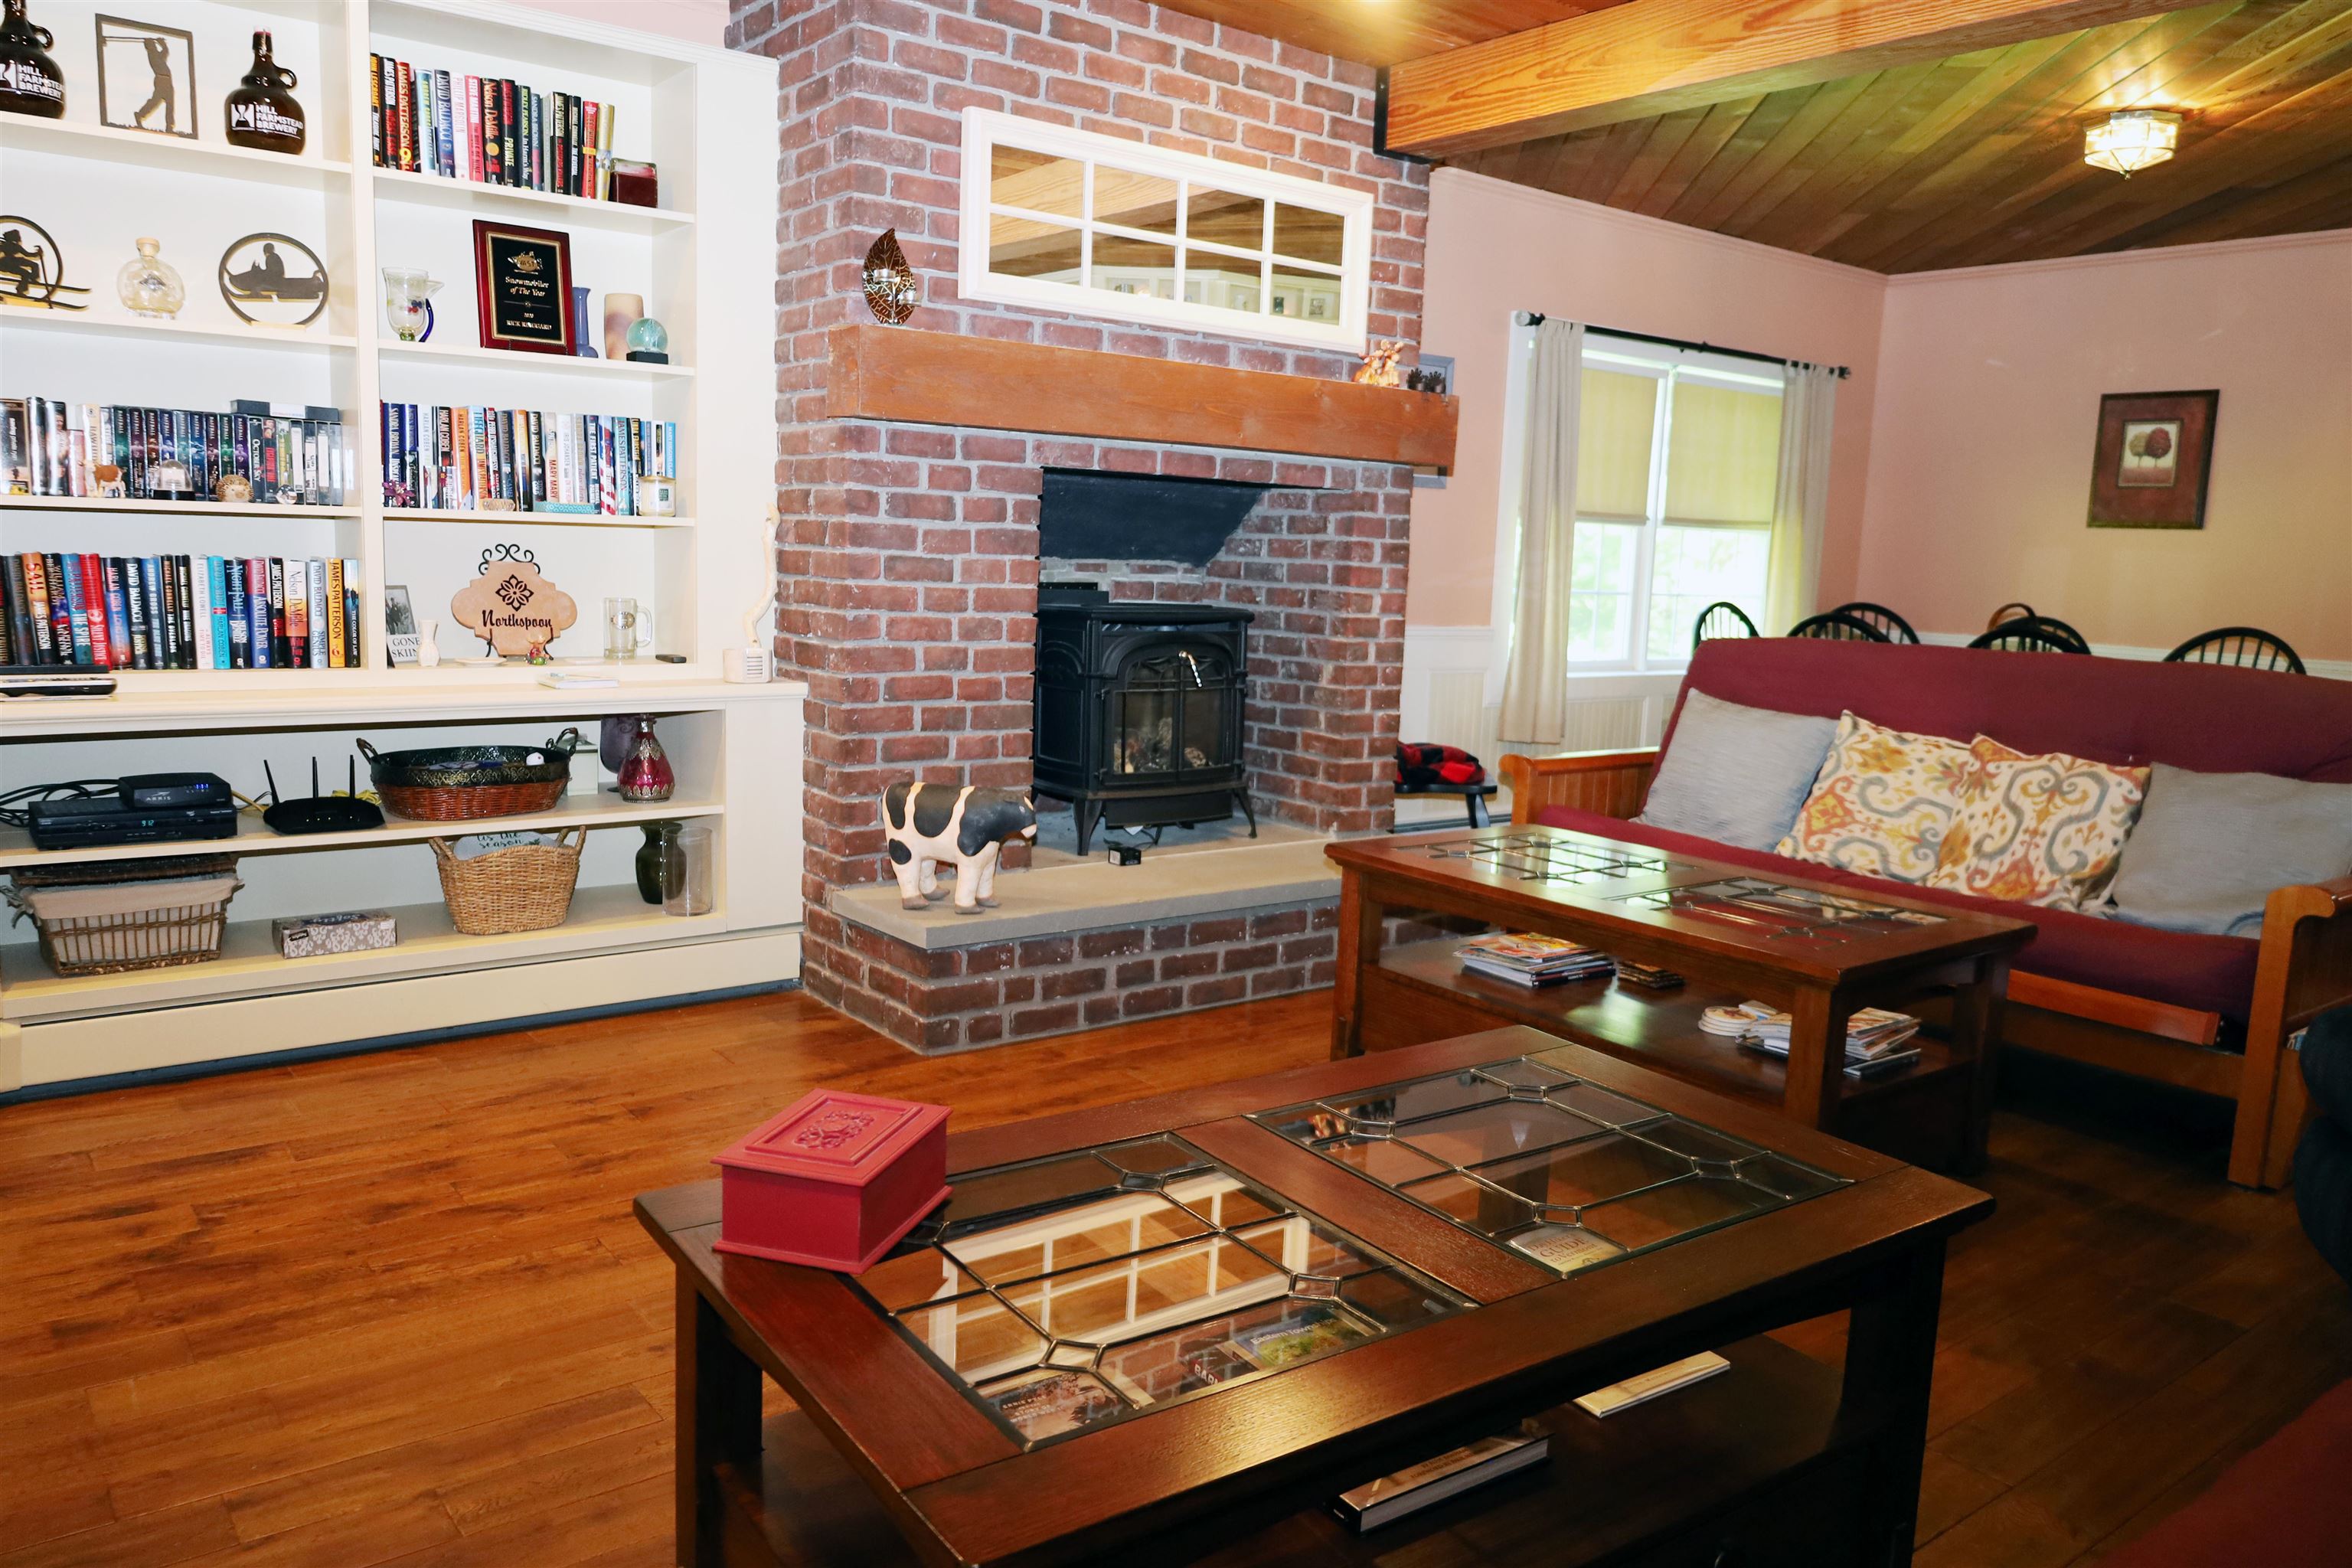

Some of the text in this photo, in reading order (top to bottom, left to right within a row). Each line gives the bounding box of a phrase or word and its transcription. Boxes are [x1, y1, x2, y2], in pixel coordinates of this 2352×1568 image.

[18, 64, 42, 77] HILL
[371, 56, 379, 71] JOHN
[384, 59, 396, 106] JAMES PATTERSON
[256, 104, 277, 115] HILL
[399, 66, 409, 146] JAMES PATTERSON
[436, 74, 452, 140] DAVID BALDACCI
[469, 78, 479, 123] STEVE MARTINI
[483, 79, 499, 139] Nelson DeMille
[256, 113, 303, 129] FARMSTEAD
[256, 121, 297, 135] BREWERY
[554, 95, 564, 137] JAMES PATTERSON
[505, 137, 514, 166] PRIVATE
[505, 276, 549, 288] Snowmobiler
[532, 289, 545, 297] Year
[390, 407, 400, 455] SANDRA BROWN
[439, 410, 450, 452] HARLAN COBEN
[474, 413, 485, 454] LIFEGUARD
[501, 413, 509, 432] DAVID
[531, 434, 541, 465] BALDACCI
[617, 420, 627, 490] JAMES PATTERSON
[550, 480, 558, 498] MARY
[147, 564, 155, 591] ANDREW
[179, 567, 188, 586] MICHAEL
[197, 563, 207, 594] ELIZABETH
[272, 564, 282, 580] JAMES
[289, 571, 302, 595] Nelson
[106, 567, 122, 611] HARLAN COBEN
[126, 564, 142, 622] DAVID BALDACCI
[150, 593, 158, 614] GROSS
[181, 586, 189, 608] CONNELLY
[273, 580, 283, 609] PATTERSON
[312, 565, 322, 617] DAVID BALDACCI
[329, 563, 341, 639] JAMES PATTERSON
[26, 563, 51, 650] SAIL JAMES PATTERSON
[164, 560, 172, 583] MICHAEL
[168, 626, 177, 653] OVERLOOK
[256, 596, 269, 626] ABSOLUTE
[286, 598, 303, 626] DeMille
[482, 609, 553, 630] Northspoon
[73, 612, 90, 646] THE SPIRE
[91, 625, 107, 660] SILENT JUSTICE
[256, 628, 269, 649] POWER
[393, 637, 420, 646] GONE
[479, 839, 524, 848] season
[1539, 1236, 1587, 1258] GUIDE
[1250, 1331, 1289, 1345] Eastern
